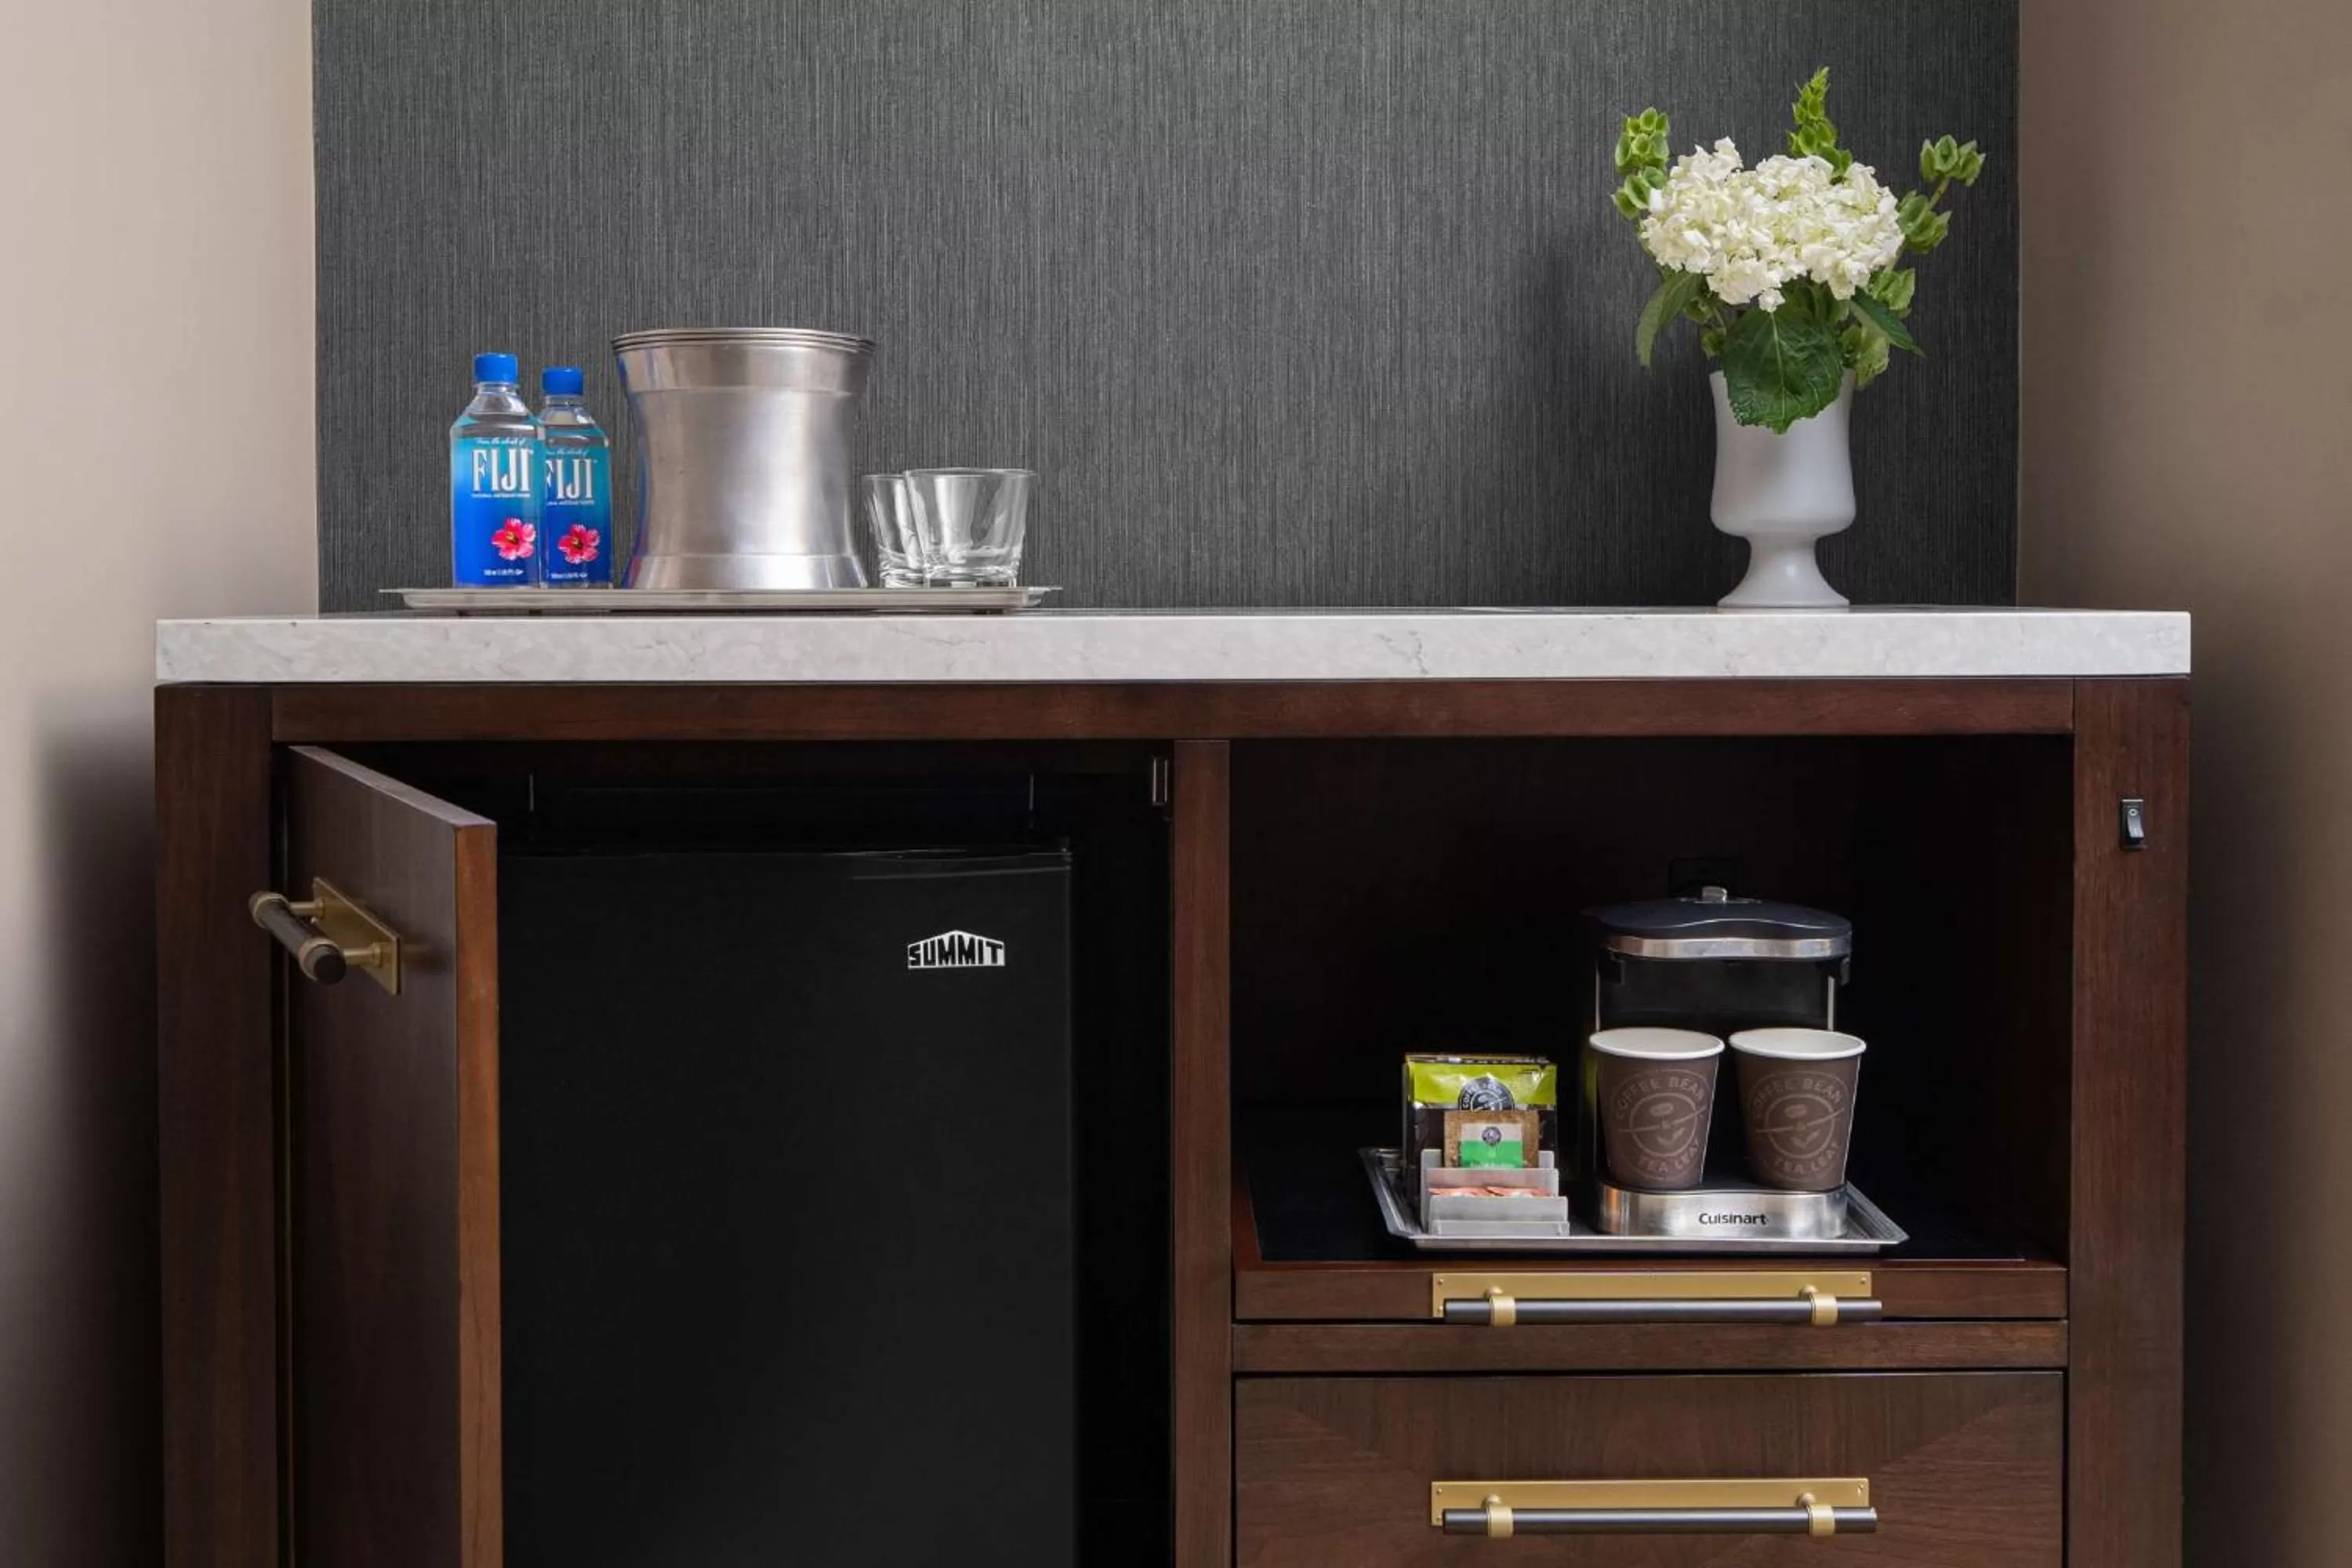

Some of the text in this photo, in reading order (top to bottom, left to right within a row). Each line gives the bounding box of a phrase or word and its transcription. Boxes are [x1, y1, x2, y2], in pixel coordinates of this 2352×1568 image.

[472, 448, 531, 492] FIJI
[909, 933, 1004, 967] SUMMIT
[1617, 1076, 1704, 1120] COFFEE BEAN
[1802, 1078, 1842, 1104] BEAN
[1698, 1212, 1766, 1225] Cuisinart
